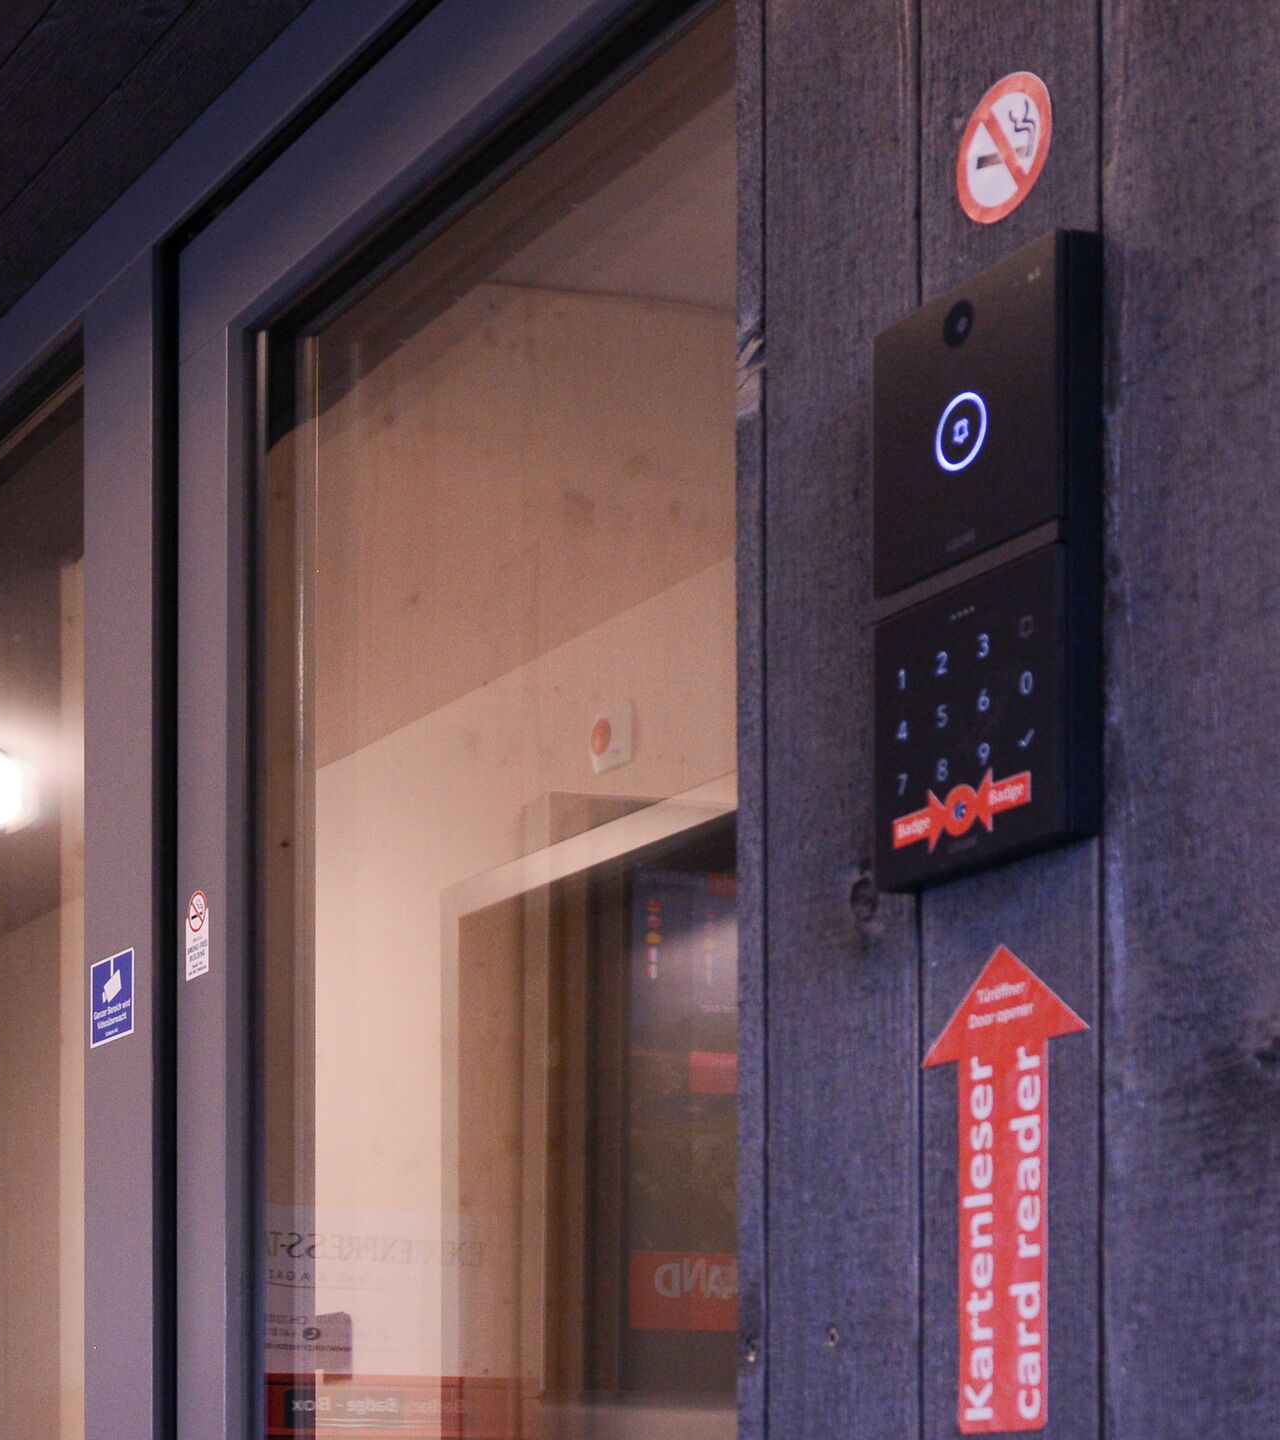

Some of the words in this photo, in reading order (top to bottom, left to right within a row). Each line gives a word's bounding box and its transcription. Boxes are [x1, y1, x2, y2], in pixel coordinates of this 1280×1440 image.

[976, 634, 990, 658] 3
[934, 650, 948, 676] 2
[897, 668, 907, 690] 1
[976, 688, 990, 712] 6
[936, 704, 948, 728] 5
[896, 720, 909, 742] 4
[976, 742, 990, 765] 9
[936, 758, 949, 782] 8
[898, 772, 908, 796] 7
[989, 782, 1024, 804] Badge
[897, 816, 931, 840] Badge
[1009, 1046, 1041, 1259] reader
[962, 1056, 994, 1422] Kartenleser
[1009, 1283, 1040, 1420] card
